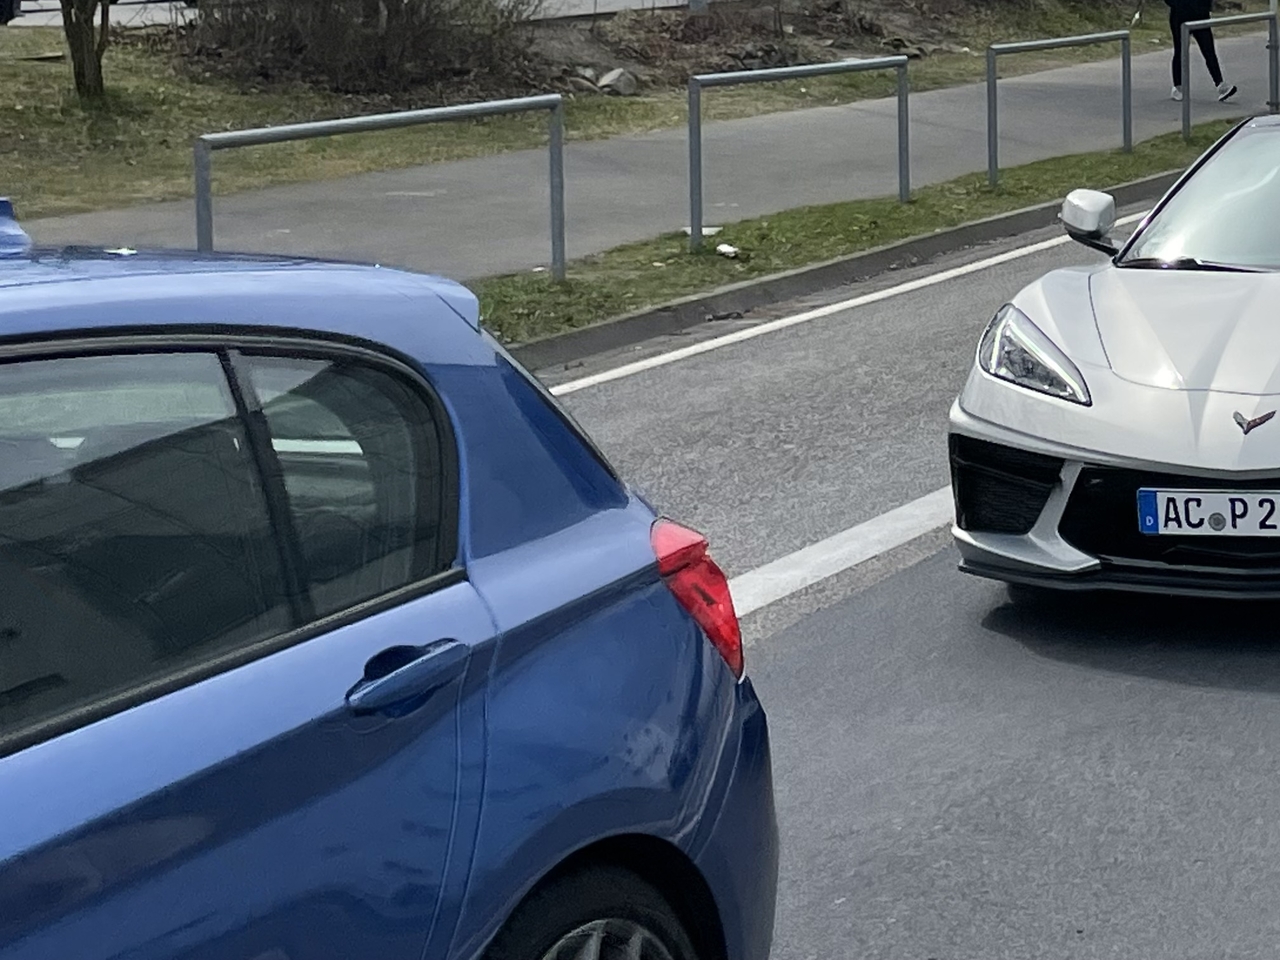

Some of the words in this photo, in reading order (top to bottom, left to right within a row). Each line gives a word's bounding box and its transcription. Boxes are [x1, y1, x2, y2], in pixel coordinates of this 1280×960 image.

[1145, 516, 1154, 526] D
[1163, 497, 1204, 528] AC
[1228, 498, 1249, 529] P
